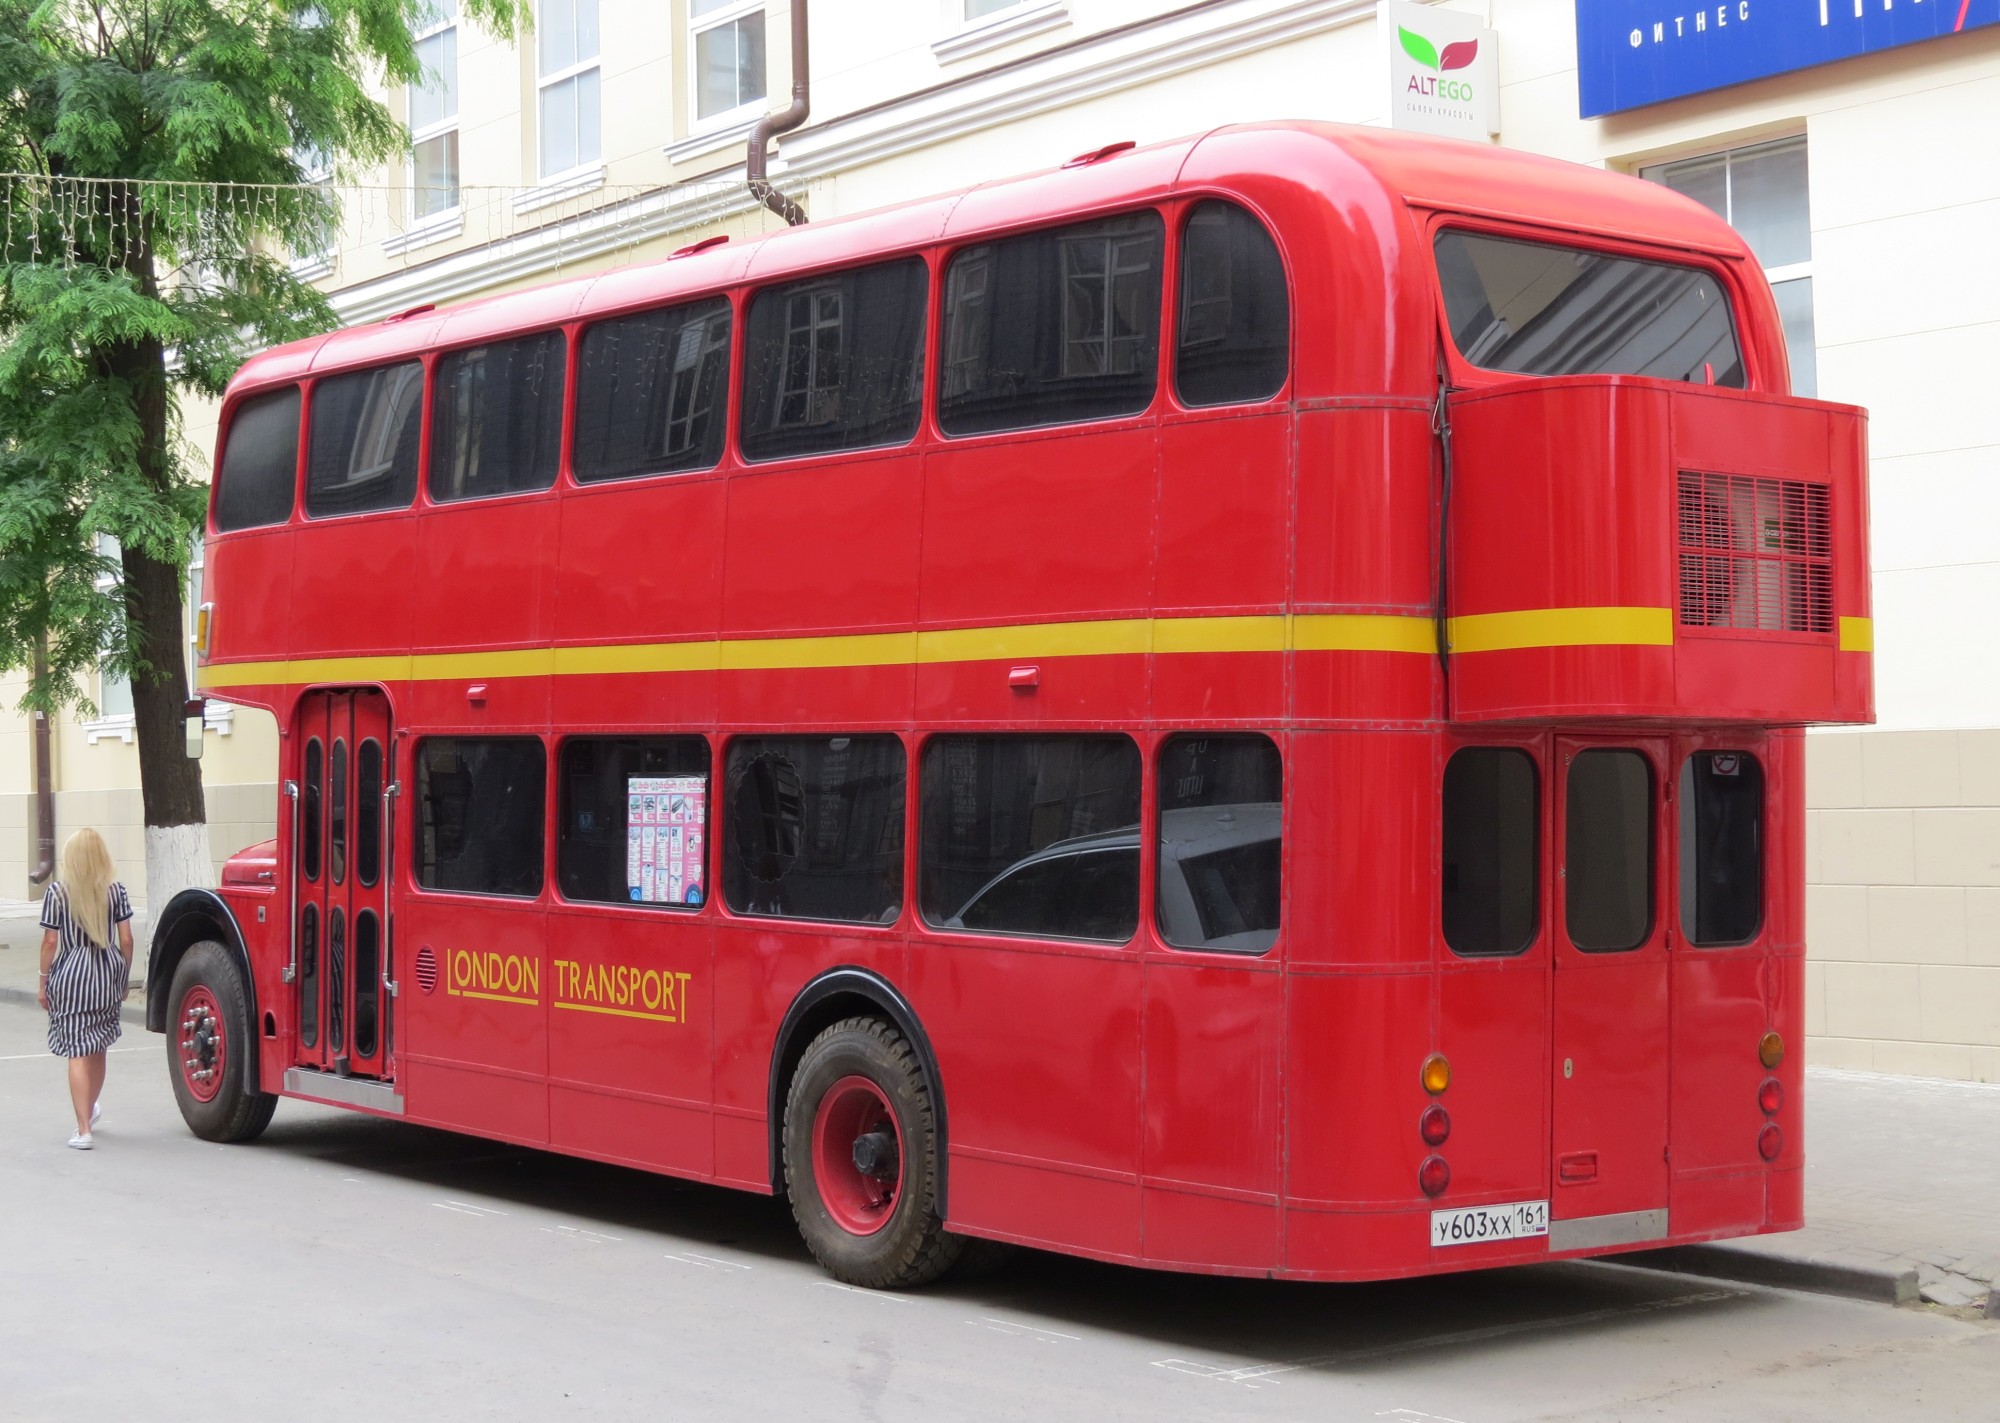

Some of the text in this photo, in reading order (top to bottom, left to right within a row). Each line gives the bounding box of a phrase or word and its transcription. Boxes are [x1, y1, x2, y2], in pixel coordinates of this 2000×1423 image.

[1630, 1, 1749, 48] ФИТНЕС
[1407, 74, 1473, 101] ALTEGO
[1406, 103, 1474, 120] САЛОН КРАСОТЫ
[447, 949, 692, 1024] LONDON TRANSPORT
[1516, 1204, 1543, 1225] 161
[1521, 1225, 1535, 1233] RUS
